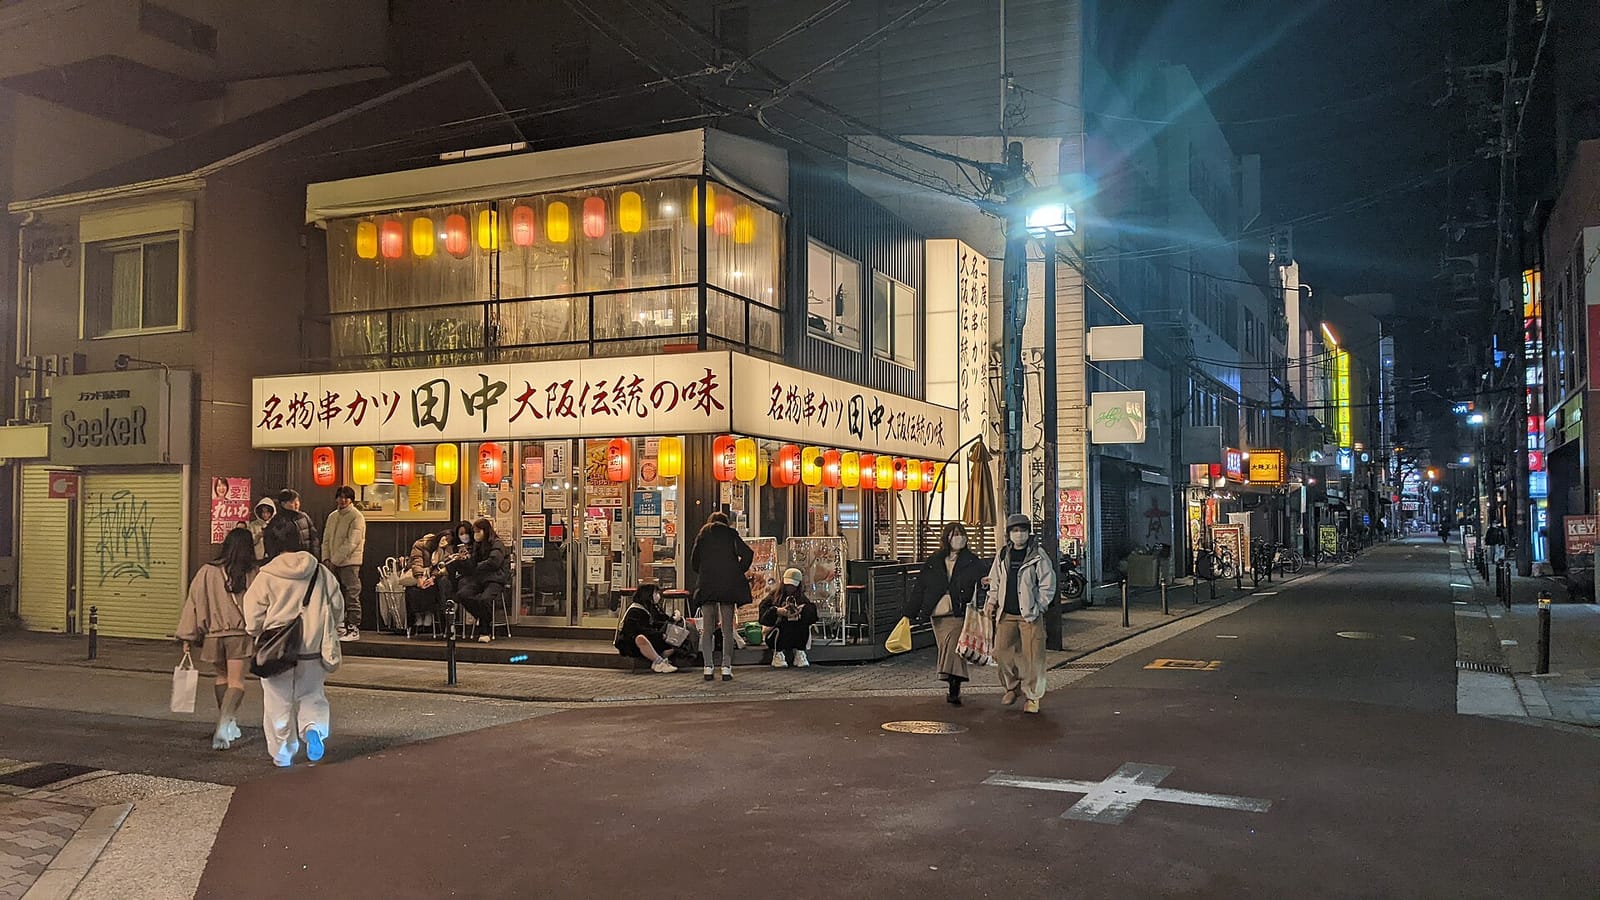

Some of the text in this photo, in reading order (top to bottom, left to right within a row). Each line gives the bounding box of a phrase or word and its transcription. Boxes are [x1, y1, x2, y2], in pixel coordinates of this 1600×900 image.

[970, 255, 979, 386] 名物串カツ
[256, 368, 725, 433] 名物串カツ 田中 大阪伝統の味
[767, 381, 945, 449] 名物串カツ 田中 大阪伝統の味
[62, 405, 147, 448] SeekeR
[212, 501, 249, 520] れいわ
[1059, 503, 1083, 513] れいわ
[213, 521, 225, 542] 太郎
[1568, 524, 1595, 535] KEY
